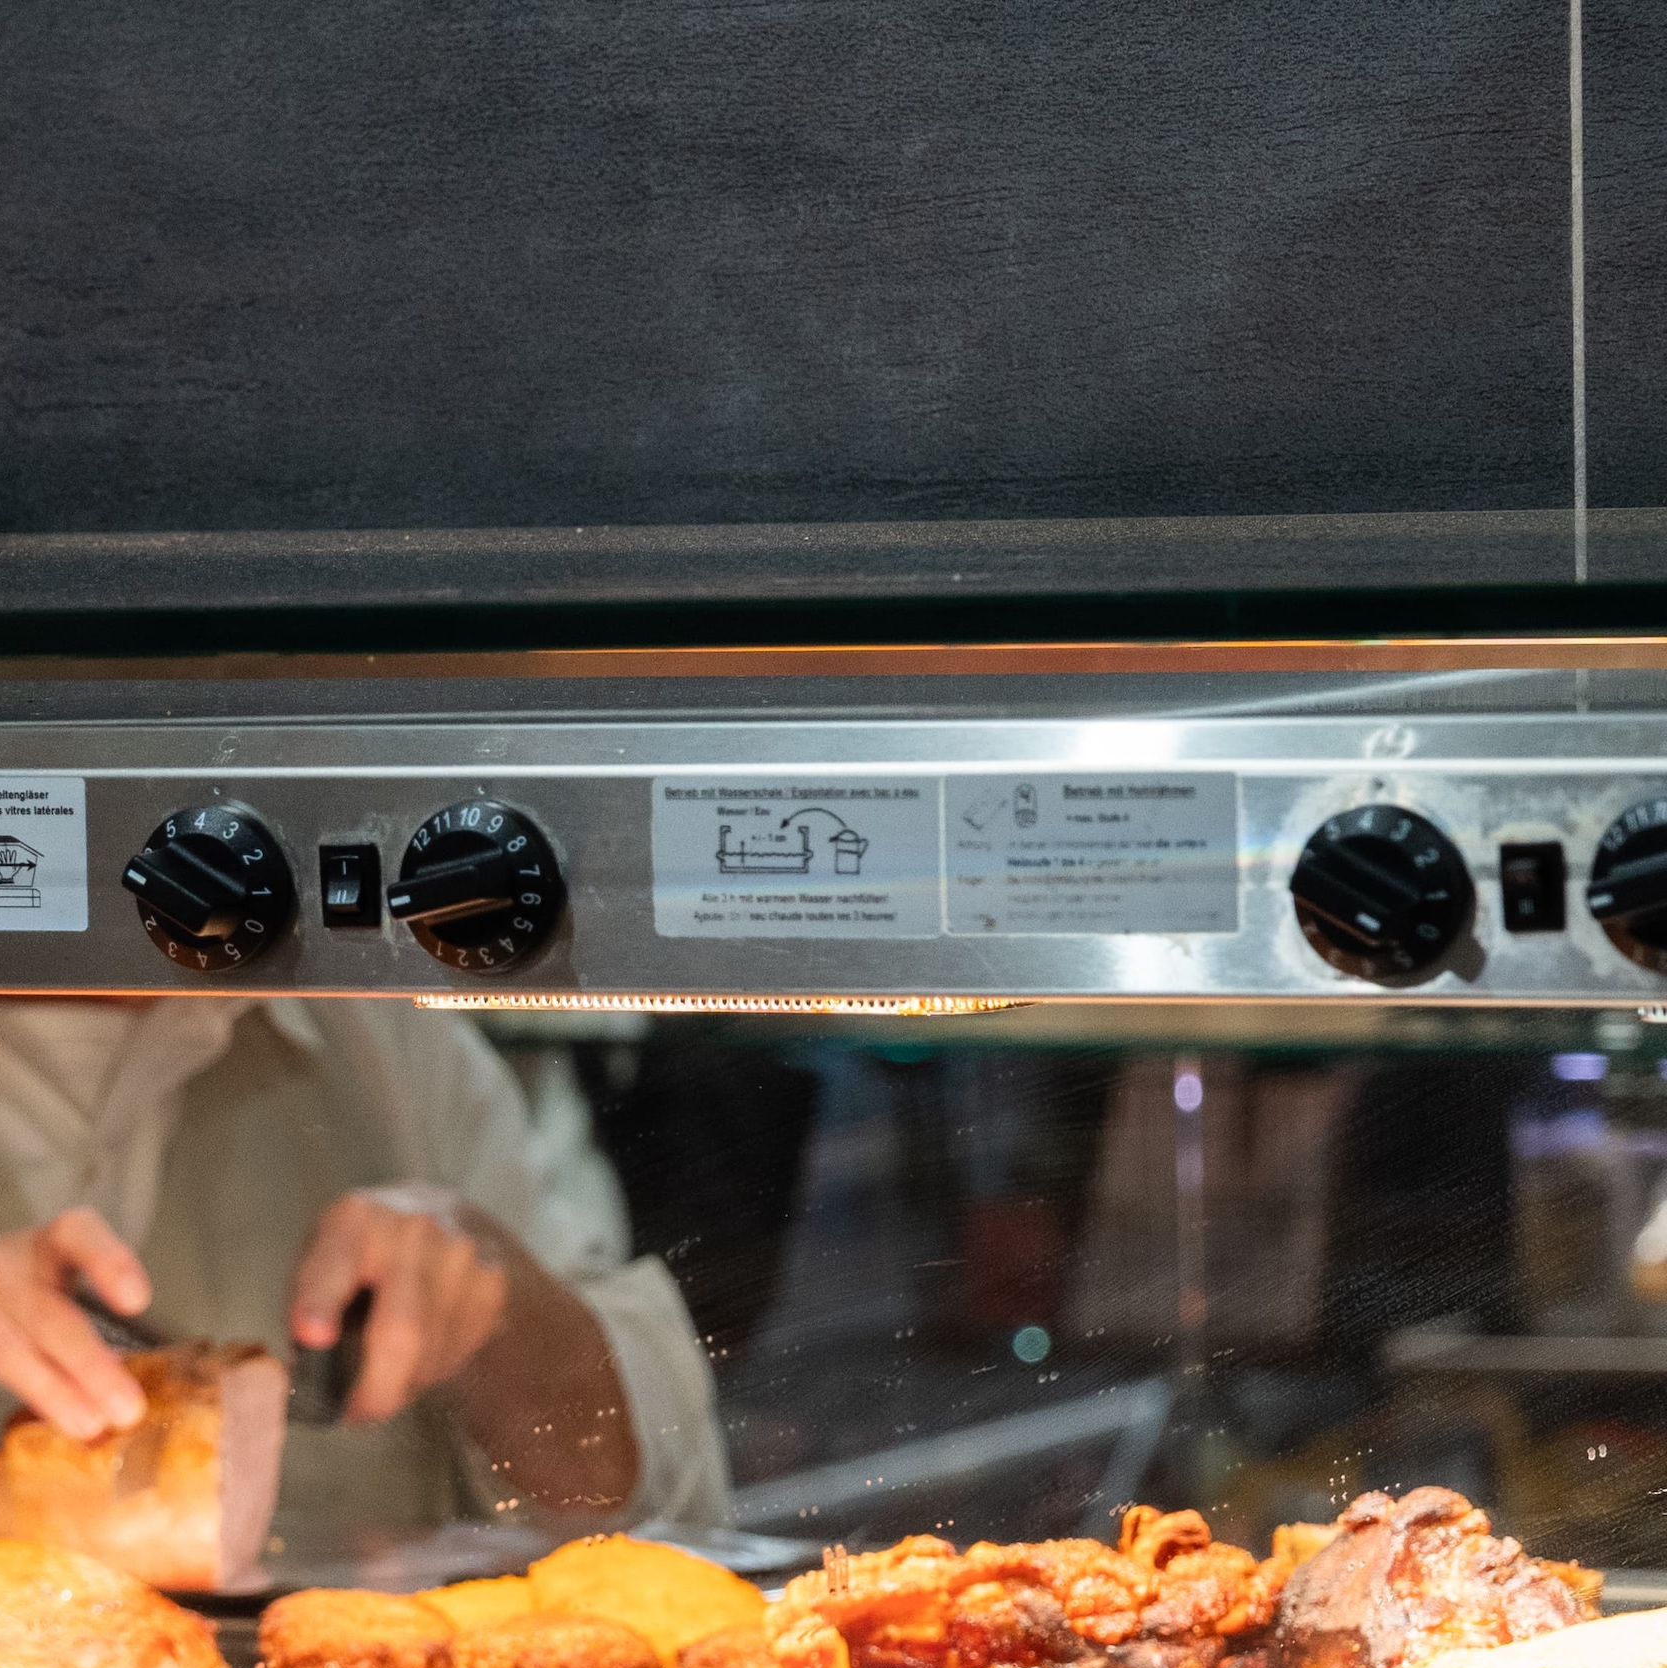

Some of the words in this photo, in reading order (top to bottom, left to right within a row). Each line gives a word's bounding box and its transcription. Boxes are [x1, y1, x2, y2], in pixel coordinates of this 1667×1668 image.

[4, 805, 31, 815] vitres
[33, 805, 73, 815] latérales
[459, 807, 481, 827] 10
[166, 819, 176, 838] 5
[194, 812, 206, 830] 4
[433, 812, 451, 833] 11
[487, 815, 504, 834] 9
[223, 821, 239, 839] 3
[413, 828, 432, 851] 12
[507, 835, 528, 852] 8
[1390, 819, 1412, 842] 3
[1414, 847, 1440, 868] 2
[242, 849, 263, 866] 2
[519, 864, 541, 877] 7
[252, 887, 272, 895] 1
[520, 892, 542, 905] 6
[145, 915, 158, 931] 2
[244, 920, 265, 933] 0
[513, 917, 534, 933] 5
[168, 941, 178, 958] 3
[224, 943, 242, 961] 5
[435, 940, 443, 956] 1
[498, 936, 515, 953] 4
[197, 951, 208, 968] 4
[457, 948, 469, 967] 2
[478, 947, 495, 965] 3
